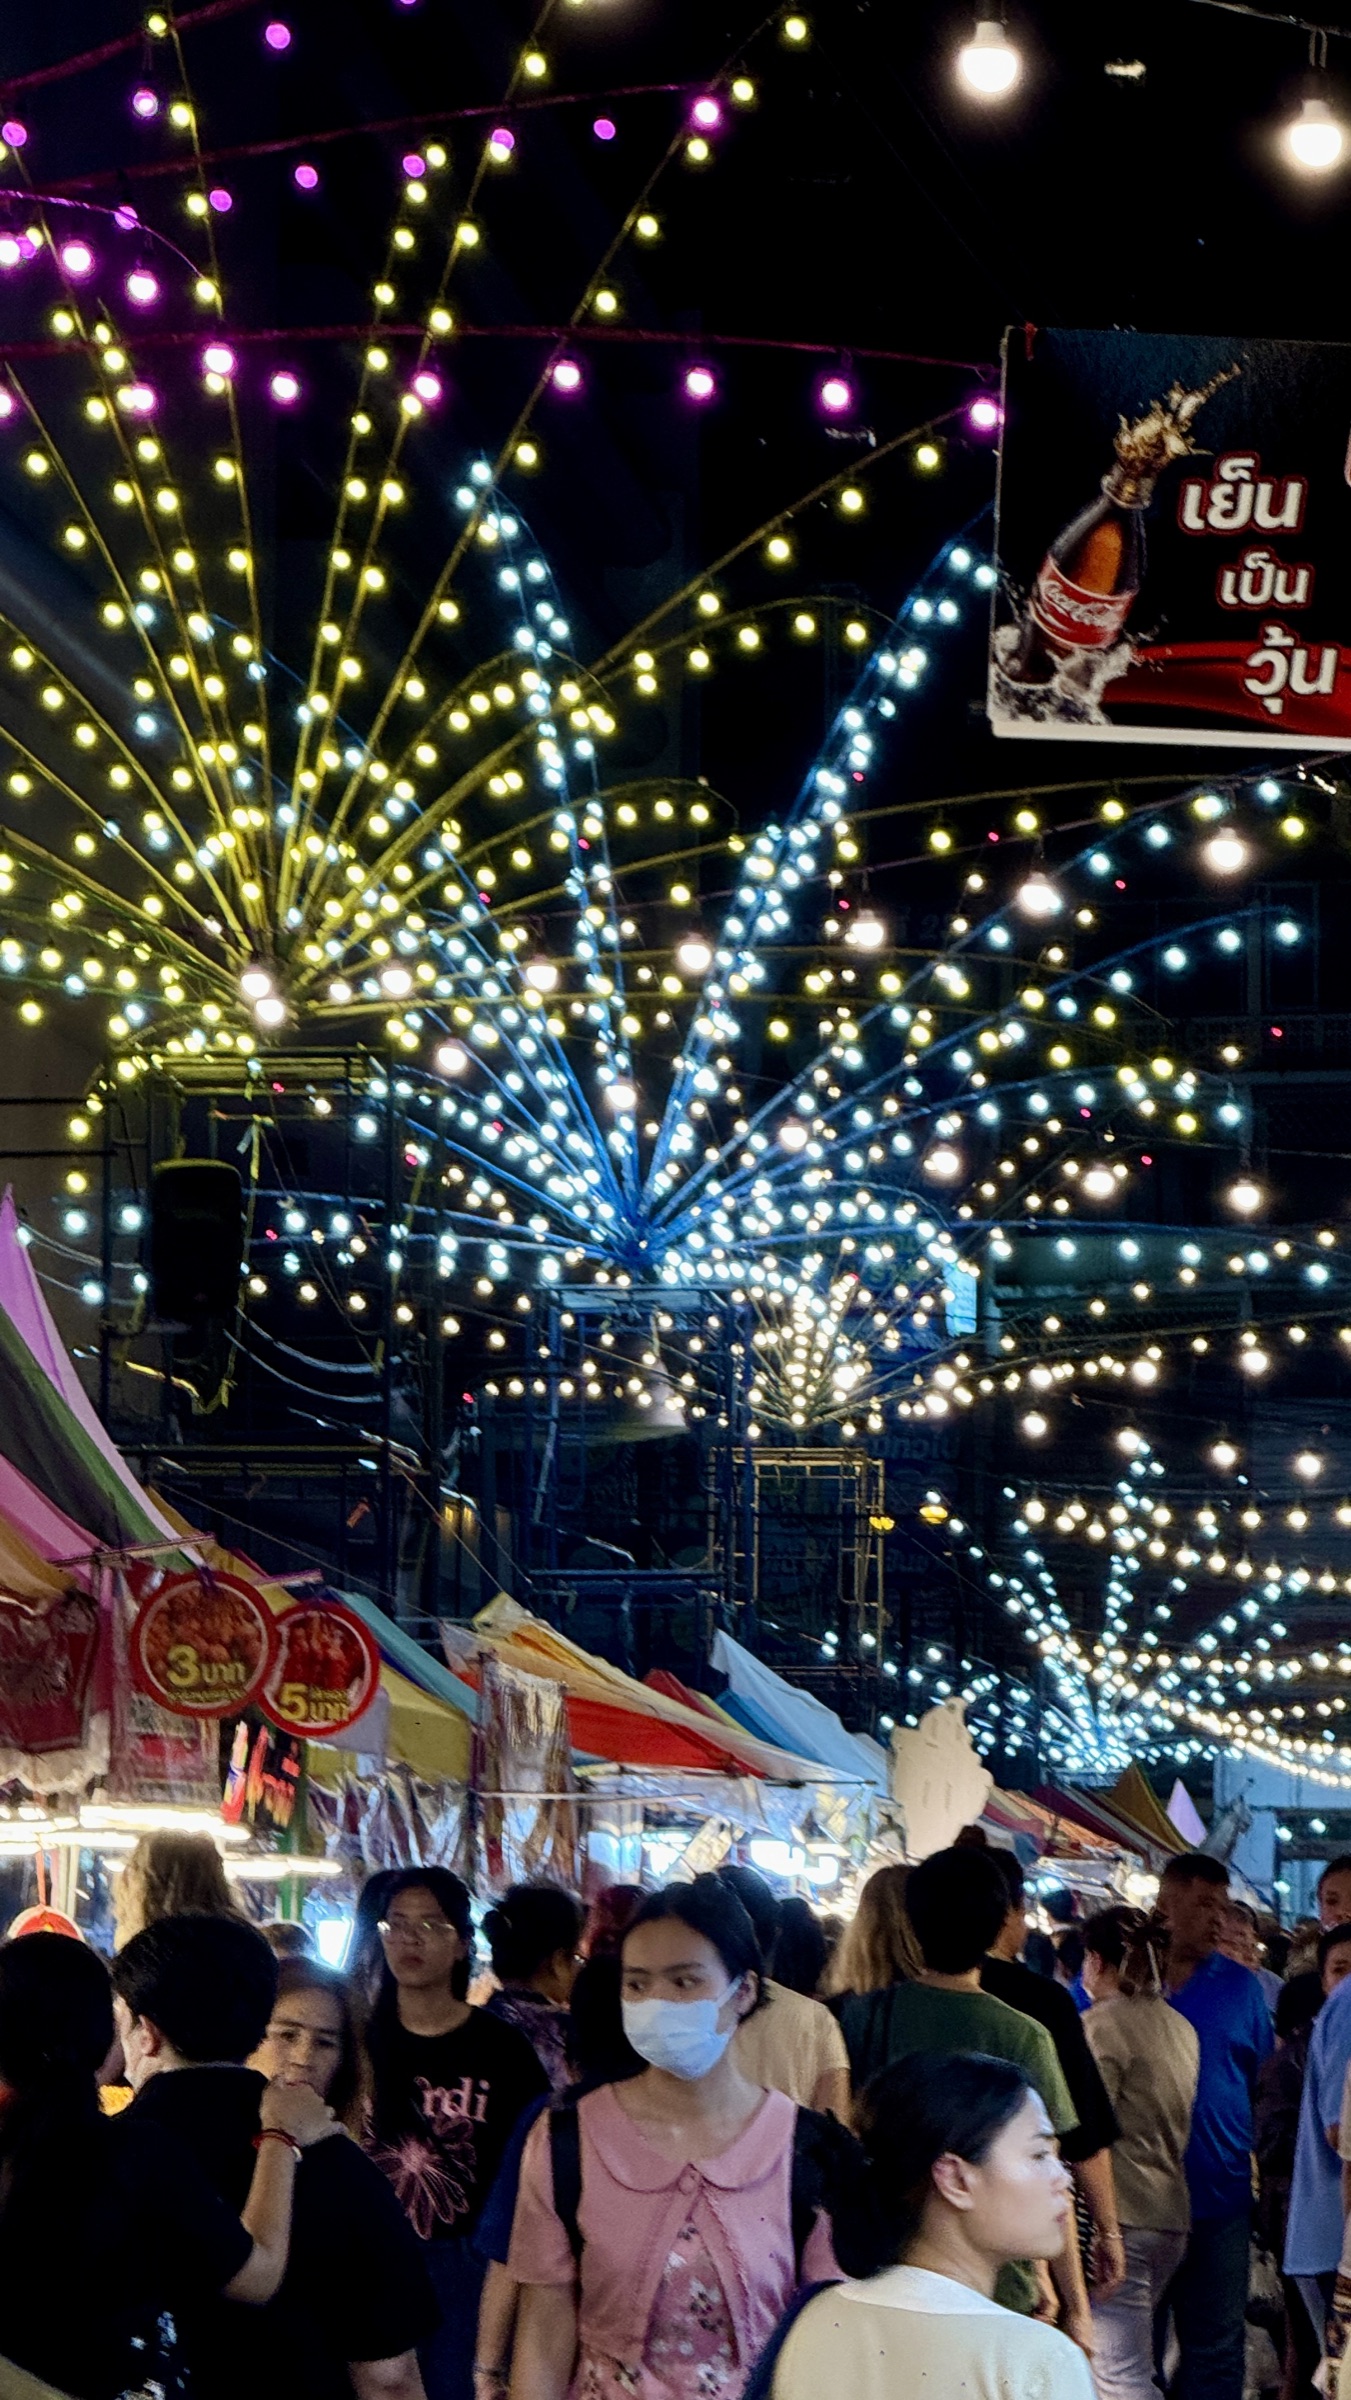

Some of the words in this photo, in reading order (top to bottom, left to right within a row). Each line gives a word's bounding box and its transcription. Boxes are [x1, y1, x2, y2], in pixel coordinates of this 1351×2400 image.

[1181, 456, 1304, 531] เย็น
[1220, 550, 1310, 606] เป็น
[1243, 624, 1339, 715] วุ้น
[166, 1643, 201, 1688] 3
[279, 1681, 309, 1722] 5
